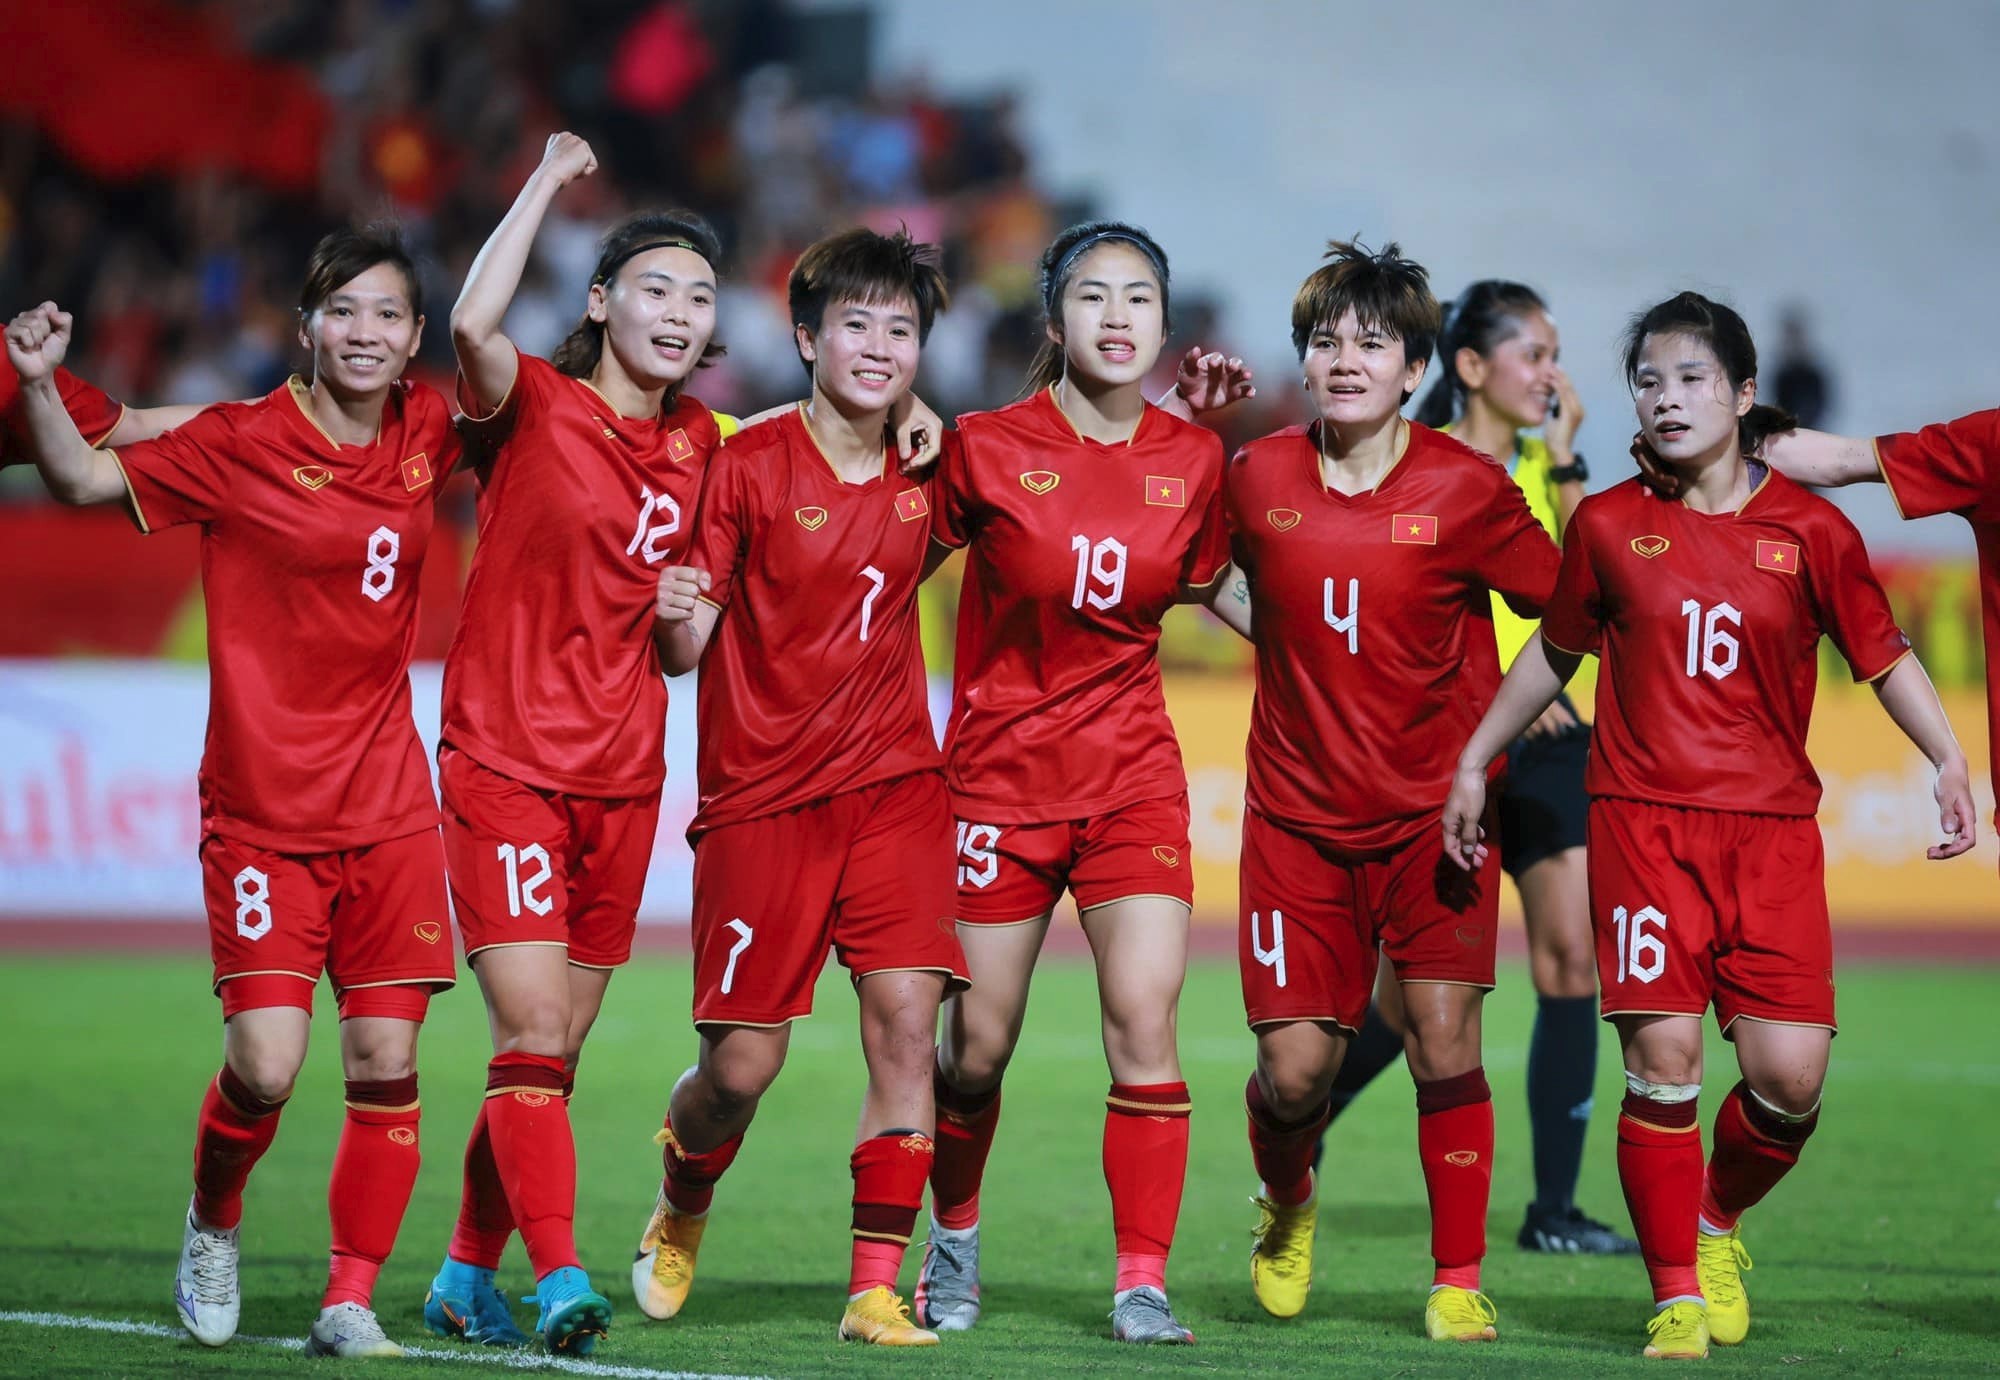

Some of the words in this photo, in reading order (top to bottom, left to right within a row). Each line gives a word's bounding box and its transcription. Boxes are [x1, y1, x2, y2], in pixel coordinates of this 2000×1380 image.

[626, 484, 681, 564] 12
[362, 525, 400, 603] 8
[859, 564, 885, 642] 7
[1071, 533, 1128, 611] 19
[1323, 576, 1359, 655] 4
[1681, 598, 1742, 681] 16
[233, 865, 272, 941] 8
[497, 842, 553, 917] 12
[721, 917, 754, 995] 7
[1251, 909, 1286, 988] 4
[1612, 904, 1667, 984] 16
